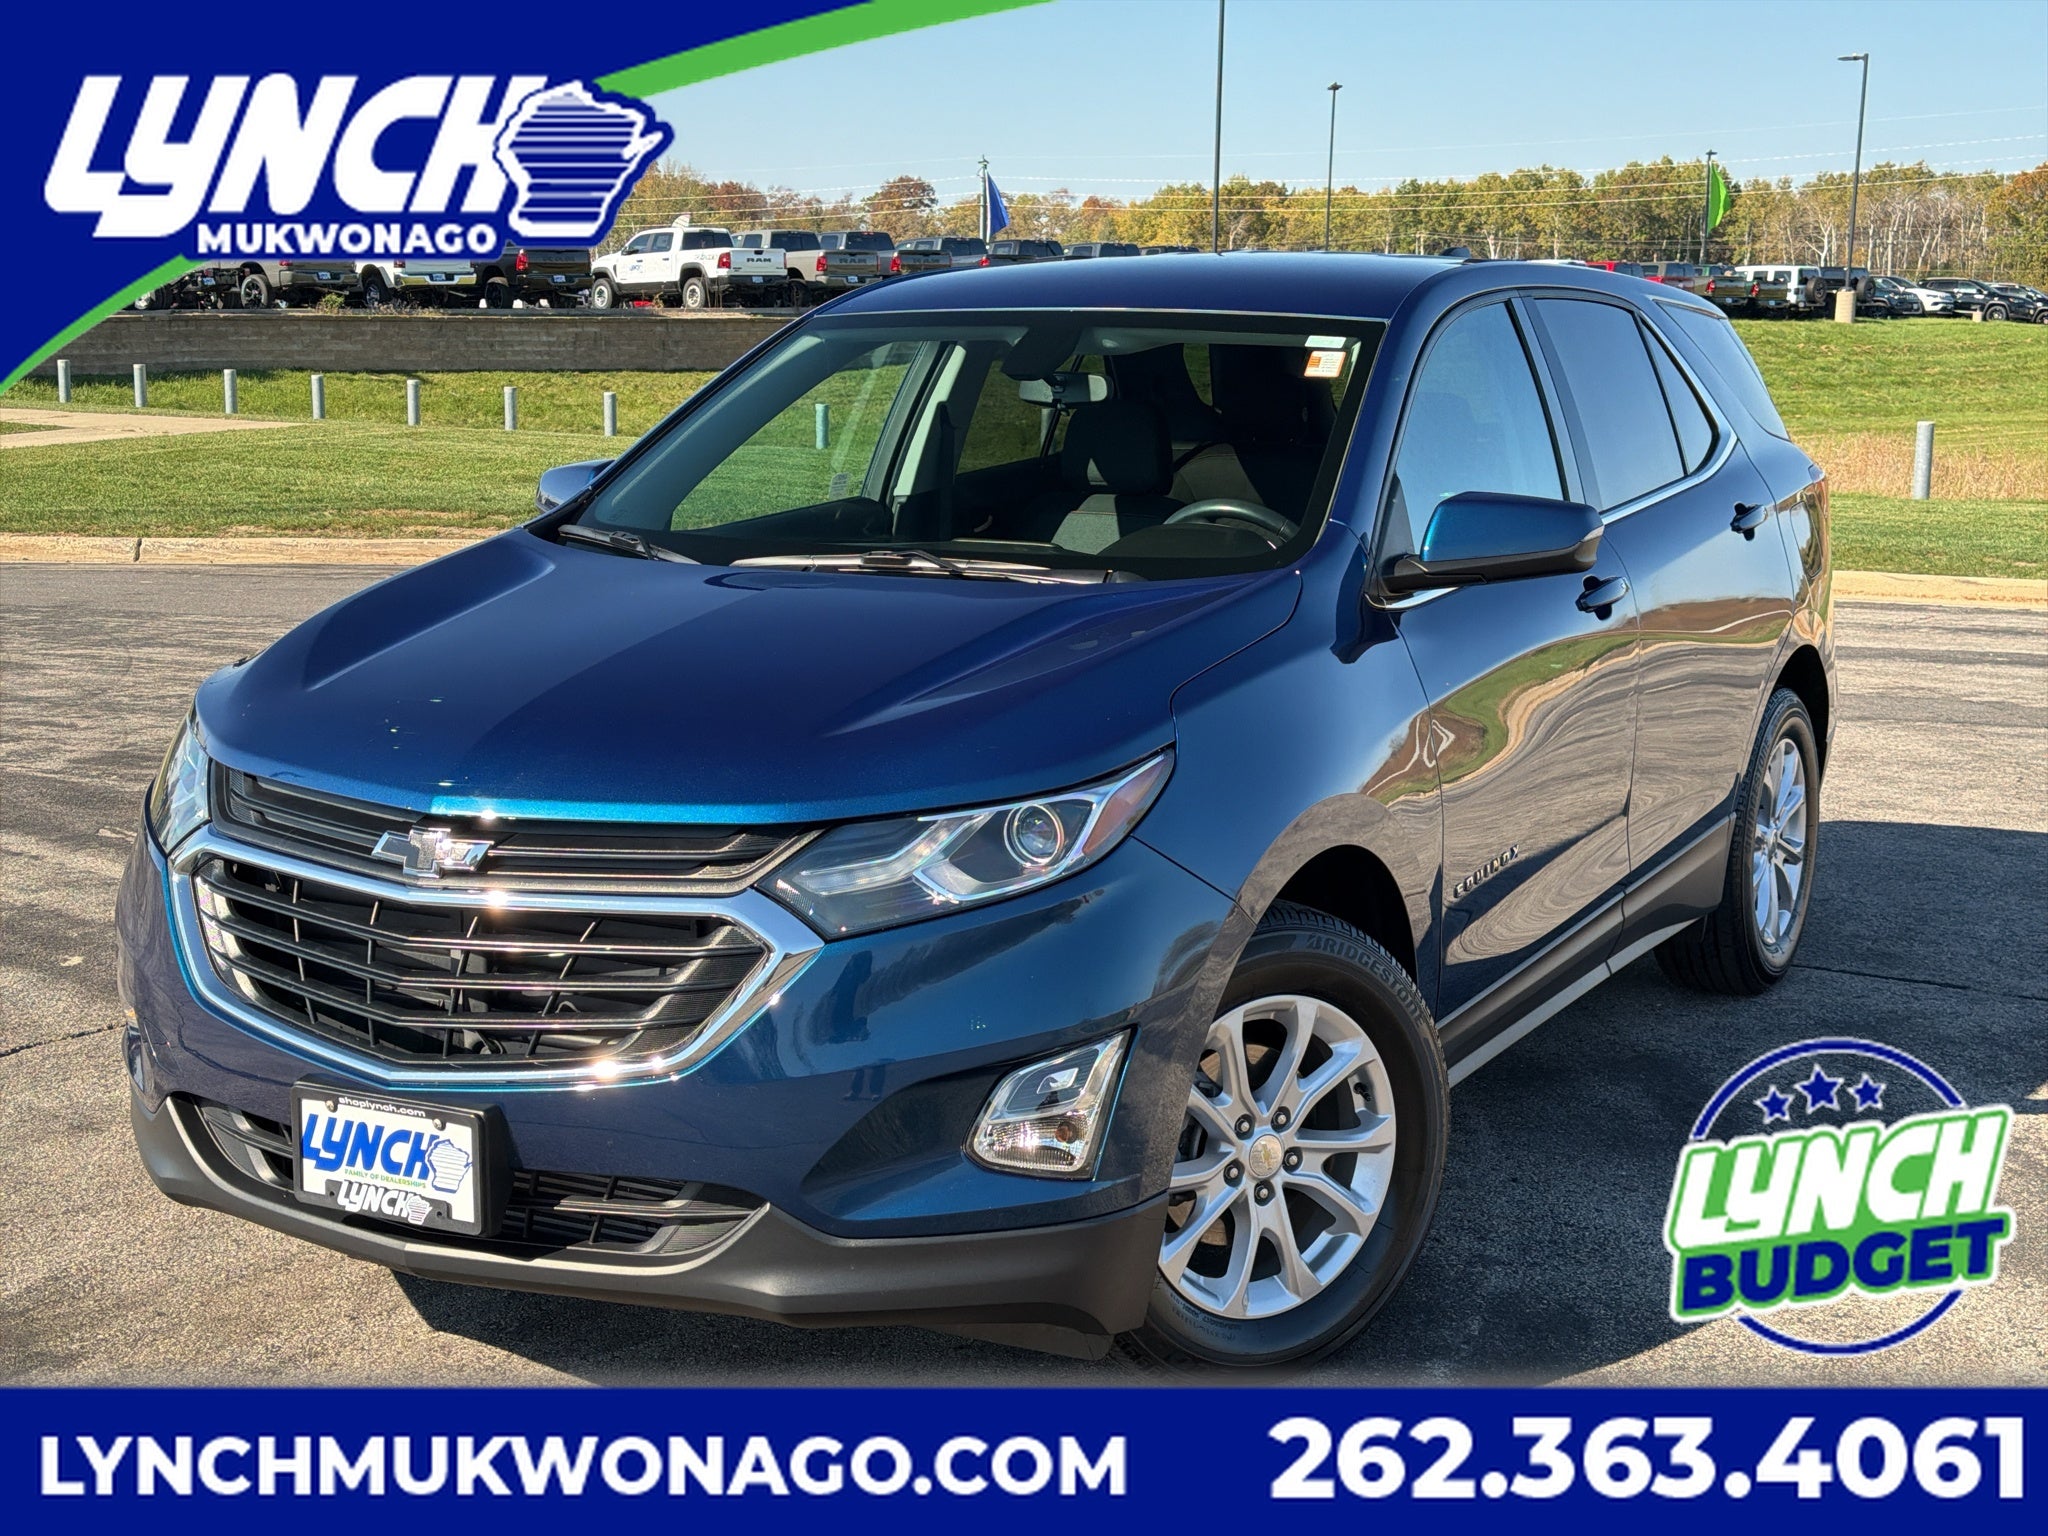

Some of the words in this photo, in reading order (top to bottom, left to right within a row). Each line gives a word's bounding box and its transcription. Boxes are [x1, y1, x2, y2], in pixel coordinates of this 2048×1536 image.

[1453, 844, 1519, 898] EQUINOX
[1306, 933, 1428, 1029] BRIDGESTONE
[338, 1096, 426, 1118] shoplynch.com
[302, 1113, 440, 1181] LYNCH
[337, 1179, 414, 1218] LYNCH
[344, 1168, 369, 1178] FAMILY
[380, 1175, 427, 1189] DEALERSHIPS
